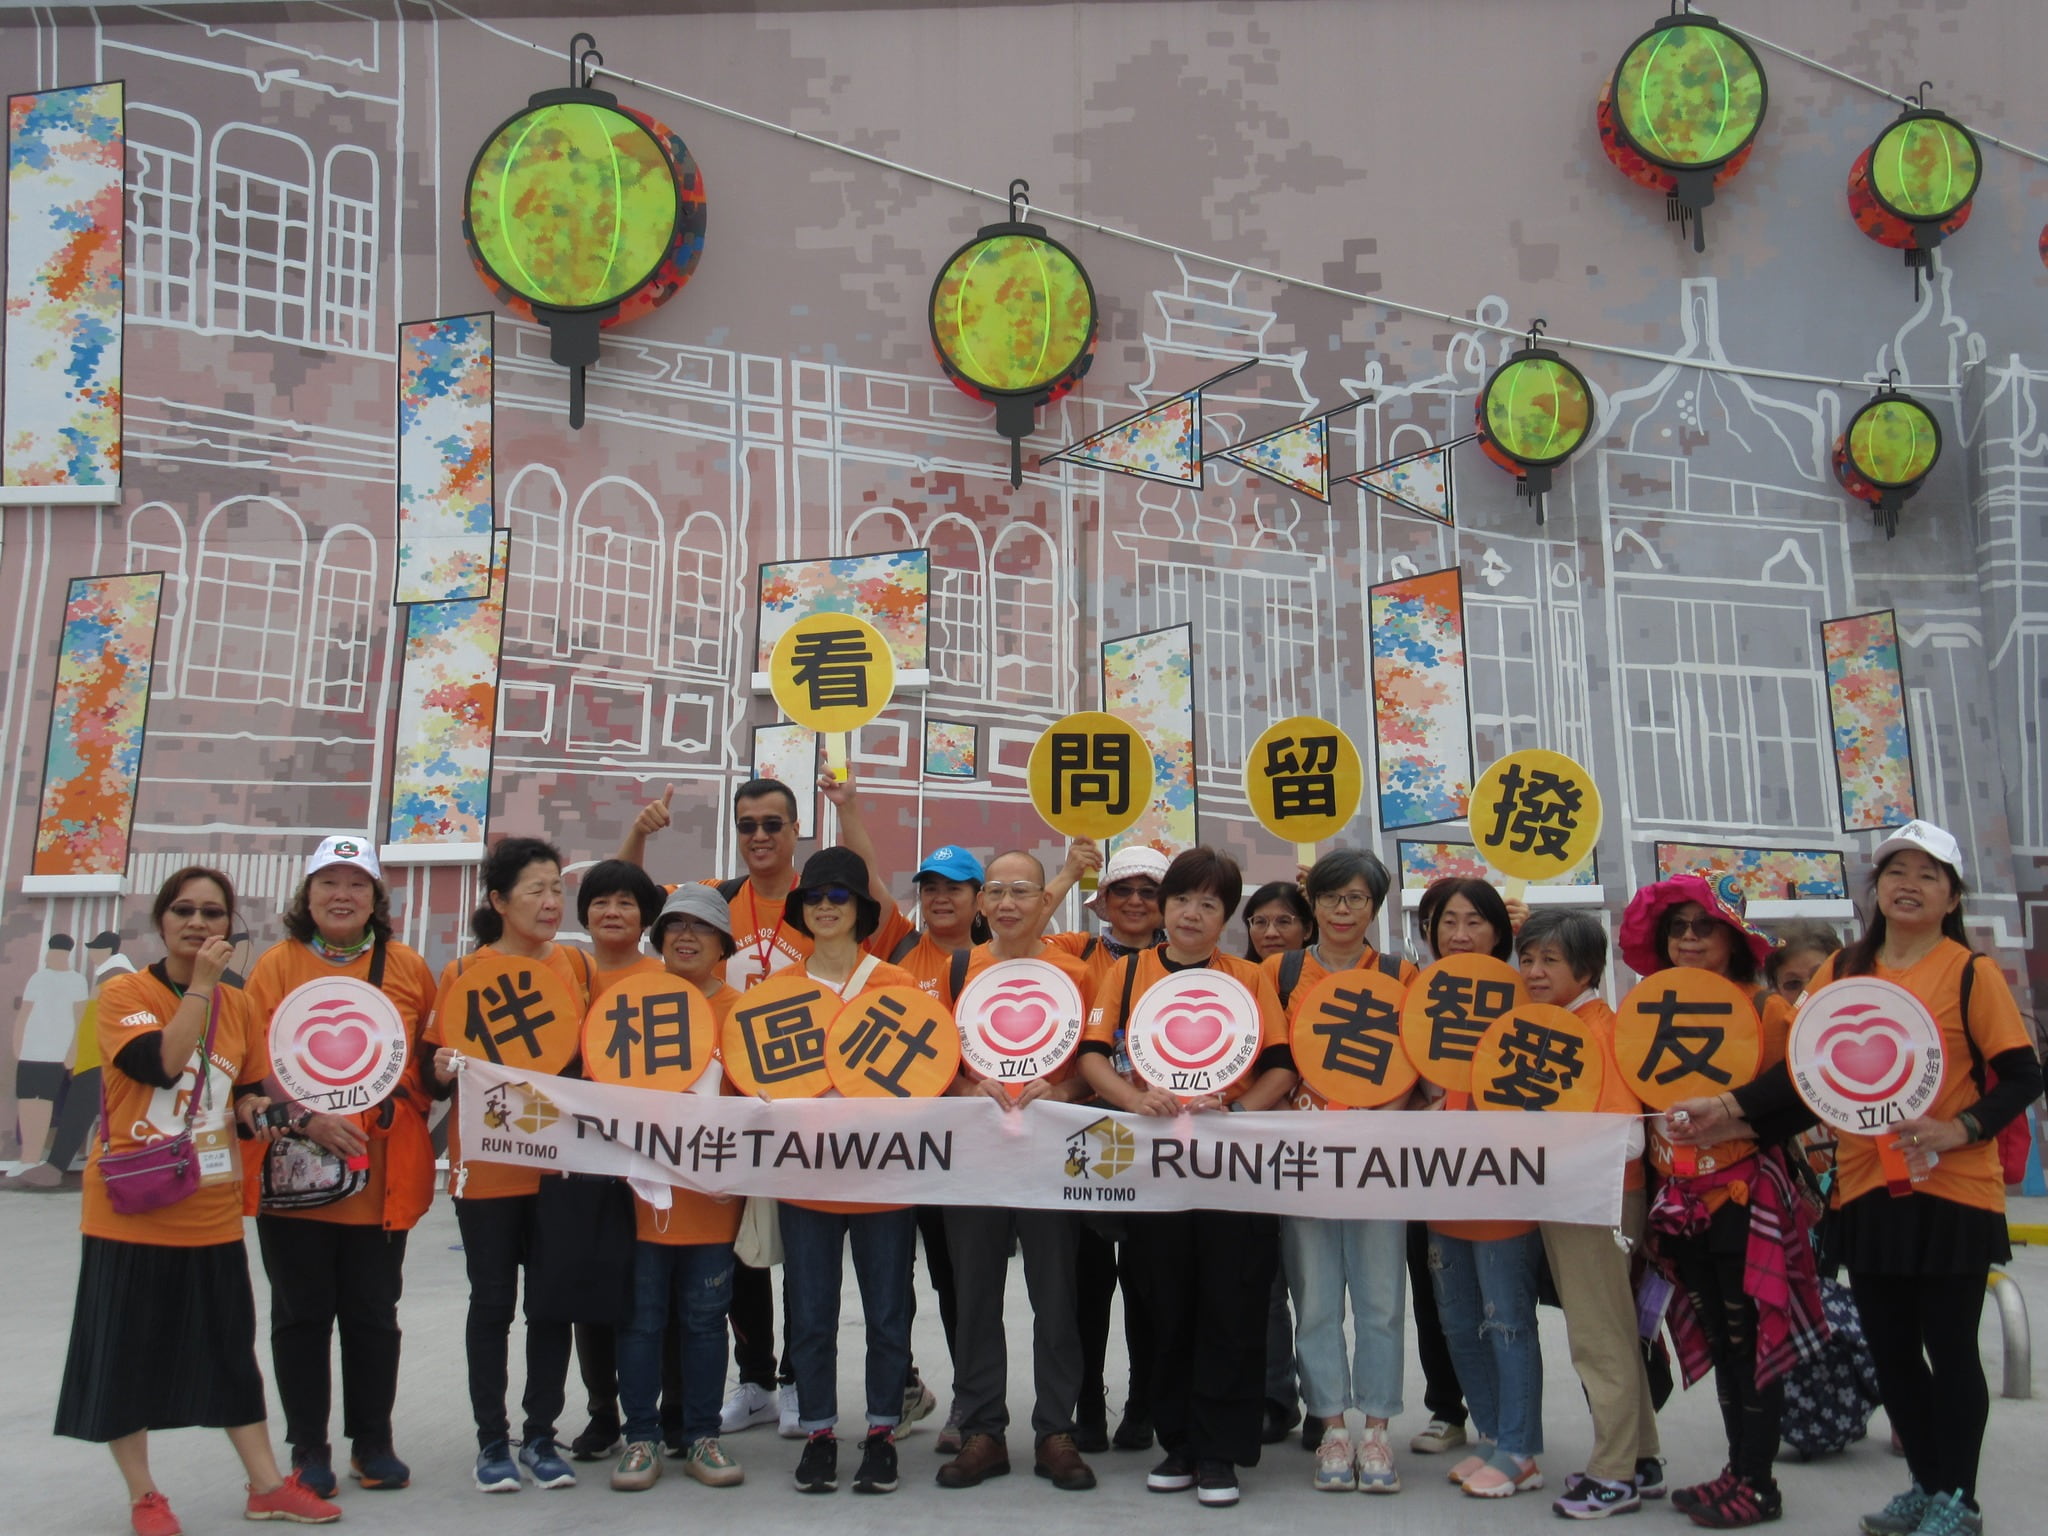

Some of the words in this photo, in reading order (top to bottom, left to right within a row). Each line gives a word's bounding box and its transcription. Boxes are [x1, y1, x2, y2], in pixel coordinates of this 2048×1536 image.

[790, 629, 873, 711] 看
[1051, 733, 1131, 815] 問
[1263, 735, 1338, 820] 留
[1484, 763, 1583, 861] 撥
[464, 970, 556, 1066] 伴
[605, 991, 692, 1079] 相
[734, 989, 826, 1084] 區
[838, 994, 938, 1097] 社
[1312, 987, 1400, 1086] 者
[1423, 969, 1516, 1062] 智
[1636, 989, 1733, 1086] 友
[327, 1085, 370, 1111] 立心
[998, 1057, 1038, 1078] 立心
[1168, 1071, 1211, 1091] 立心
[1483, 1017, 1585, 1112] 愛
[481, 1136, 512, 1154] RUN
[516, 1141, 558, 1160] TOMO
[1855, 1101, 1906, 1130] 立心
[1063, 1186, 1092, 1201] RUN
[1096, 1187, 1136, 1202] TOMO
[1151, 1137, 1546, 1192] RUN伴TAIWAN
